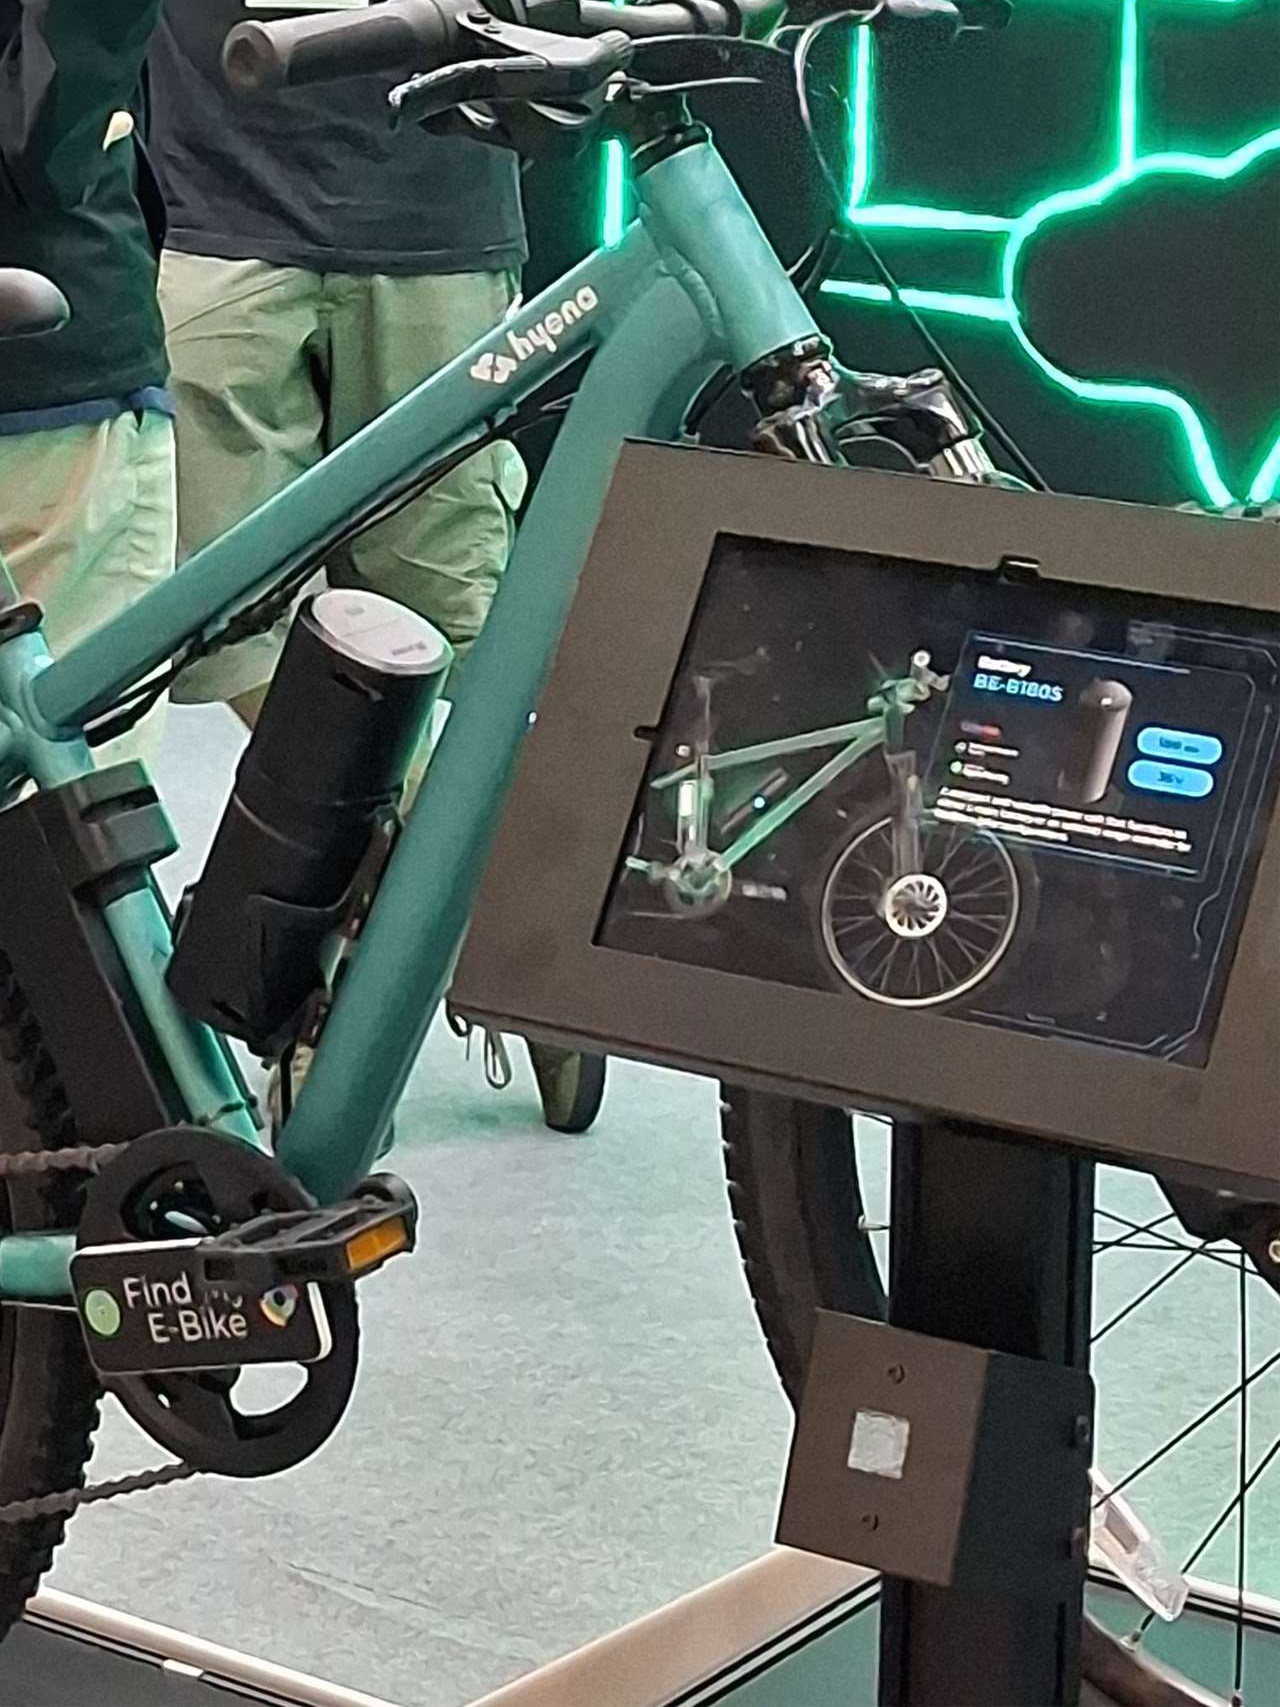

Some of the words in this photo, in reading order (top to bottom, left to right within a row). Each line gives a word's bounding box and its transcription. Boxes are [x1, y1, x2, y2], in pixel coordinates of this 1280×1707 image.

[506, 286, 599, 361] hyena
[123, 1272, 192, 1309] Find
[147, 1307, 248, 1344] E-Bike
